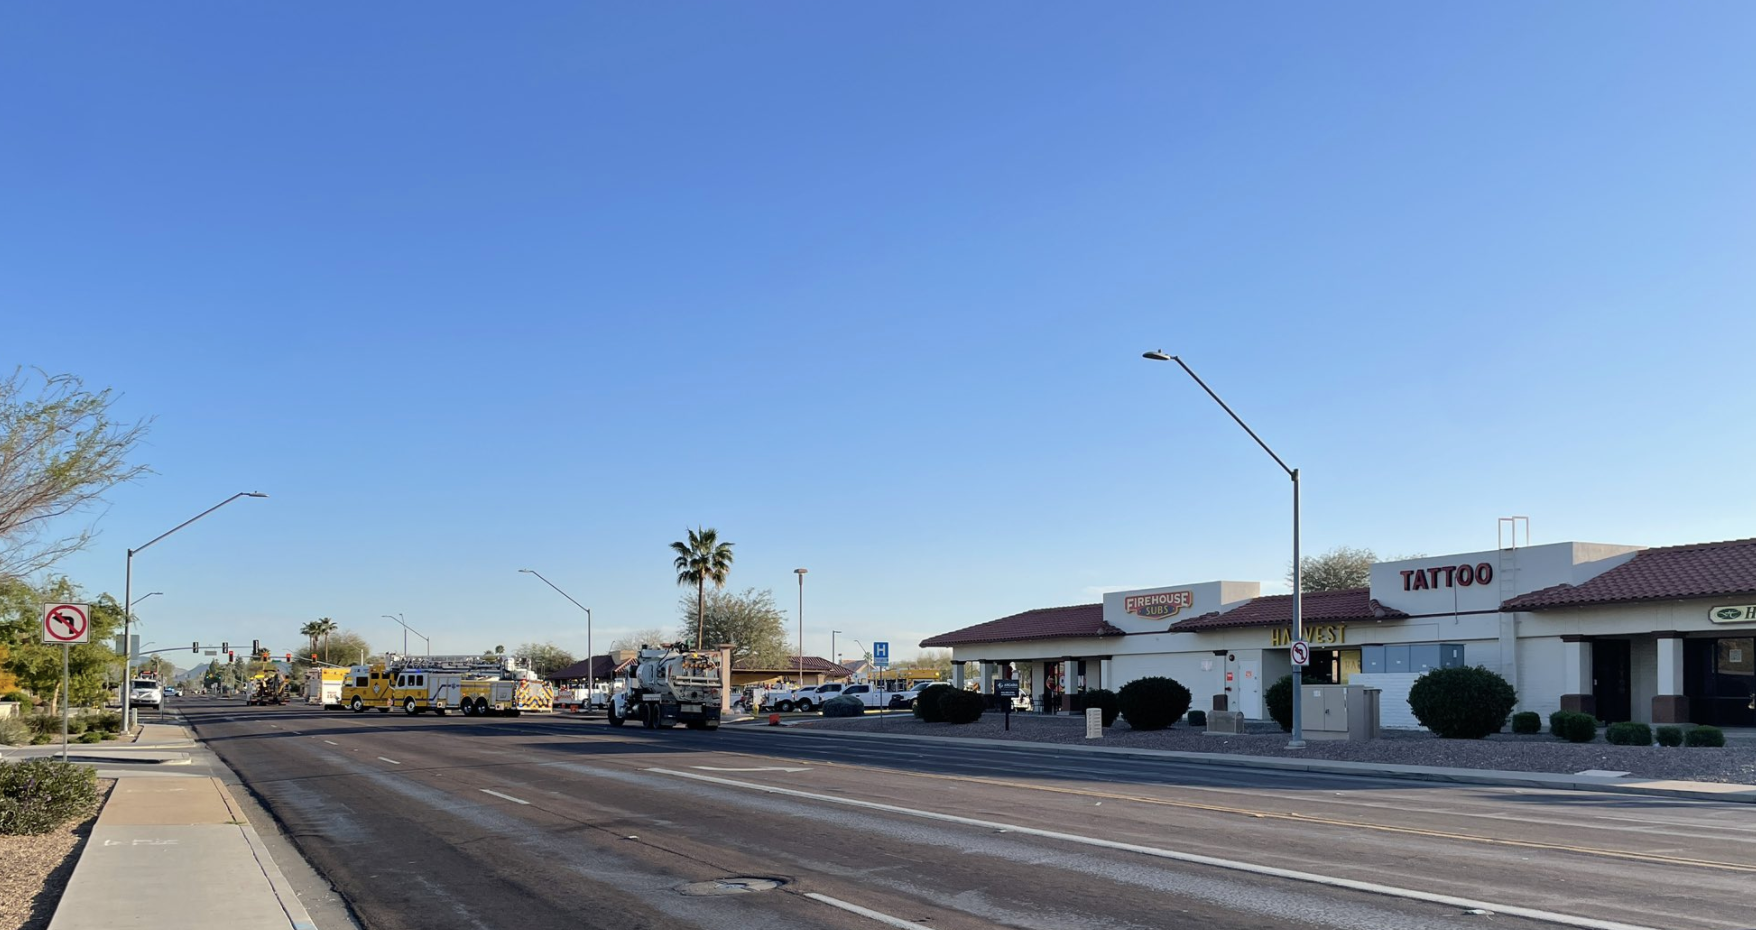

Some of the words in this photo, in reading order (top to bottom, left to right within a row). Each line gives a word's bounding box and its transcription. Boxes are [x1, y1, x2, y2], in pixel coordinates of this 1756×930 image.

[1400, 562, 1493, 591] TATTOO
[1127, 592, 1188, 612] FIREHOUSE
[1146, 605, 1168, 615] SUBS
[1271, 625, 1346, 646] HAVEST
[877, 644, 886, 656] H
